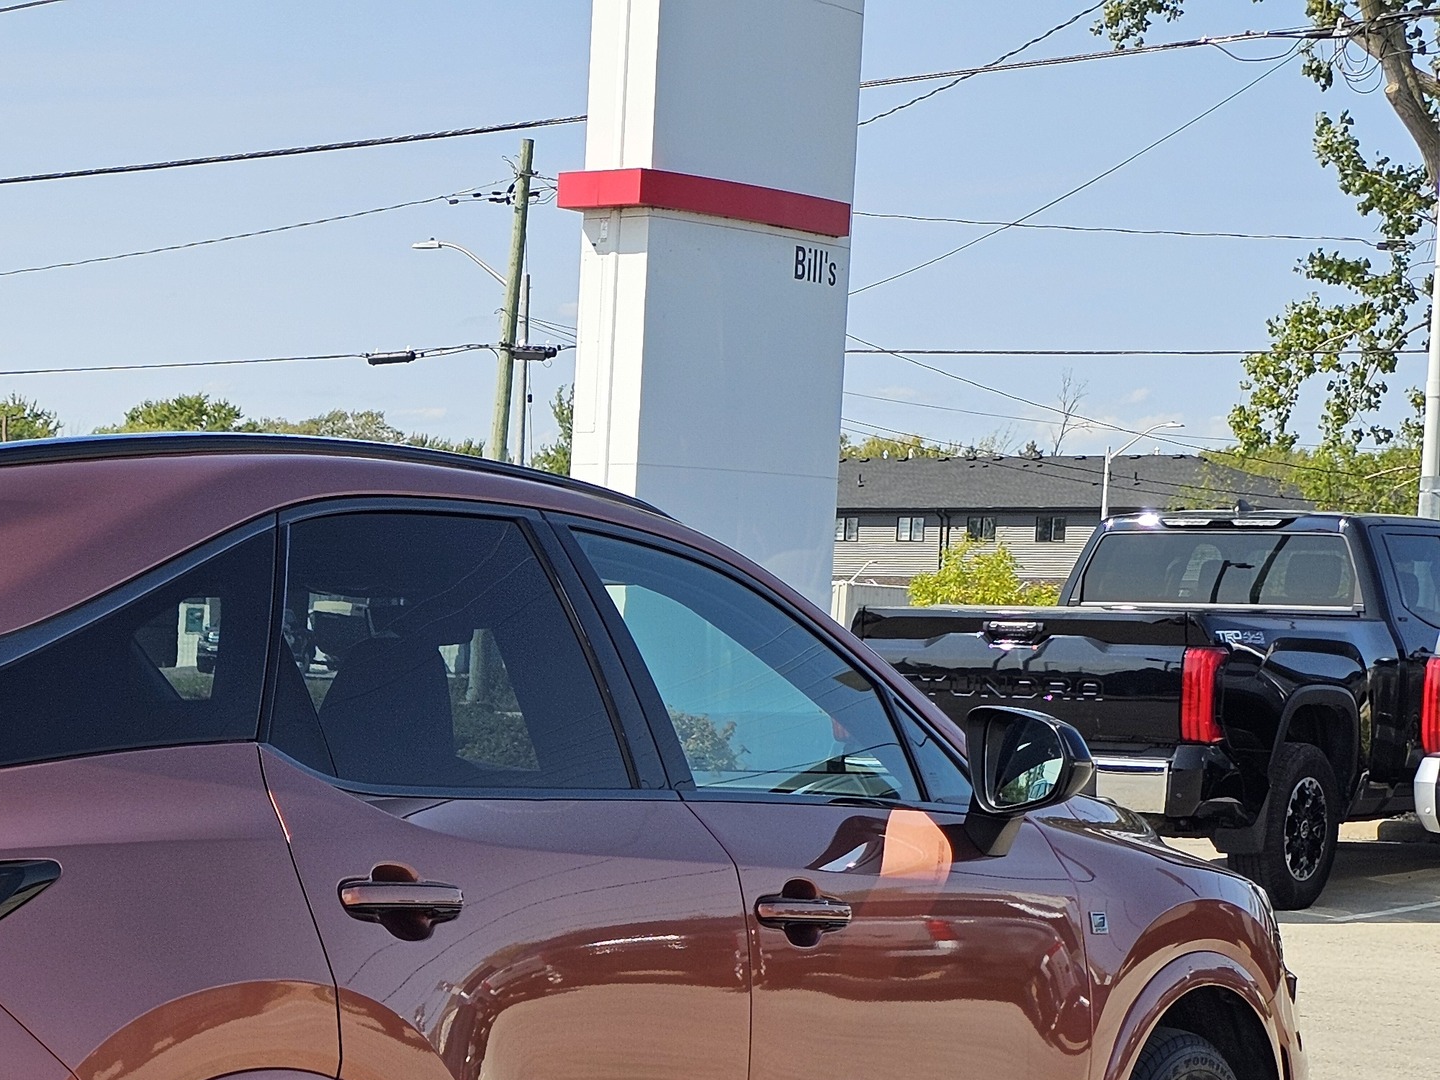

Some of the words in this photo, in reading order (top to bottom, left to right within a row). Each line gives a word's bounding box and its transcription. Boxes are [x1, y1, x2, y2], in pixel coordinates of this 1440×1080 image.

[794, 245, 837, 287] Bill's
[1215, 630, 1242, 643] TRD
[918, 673, 1105, 702] TUNDRA
